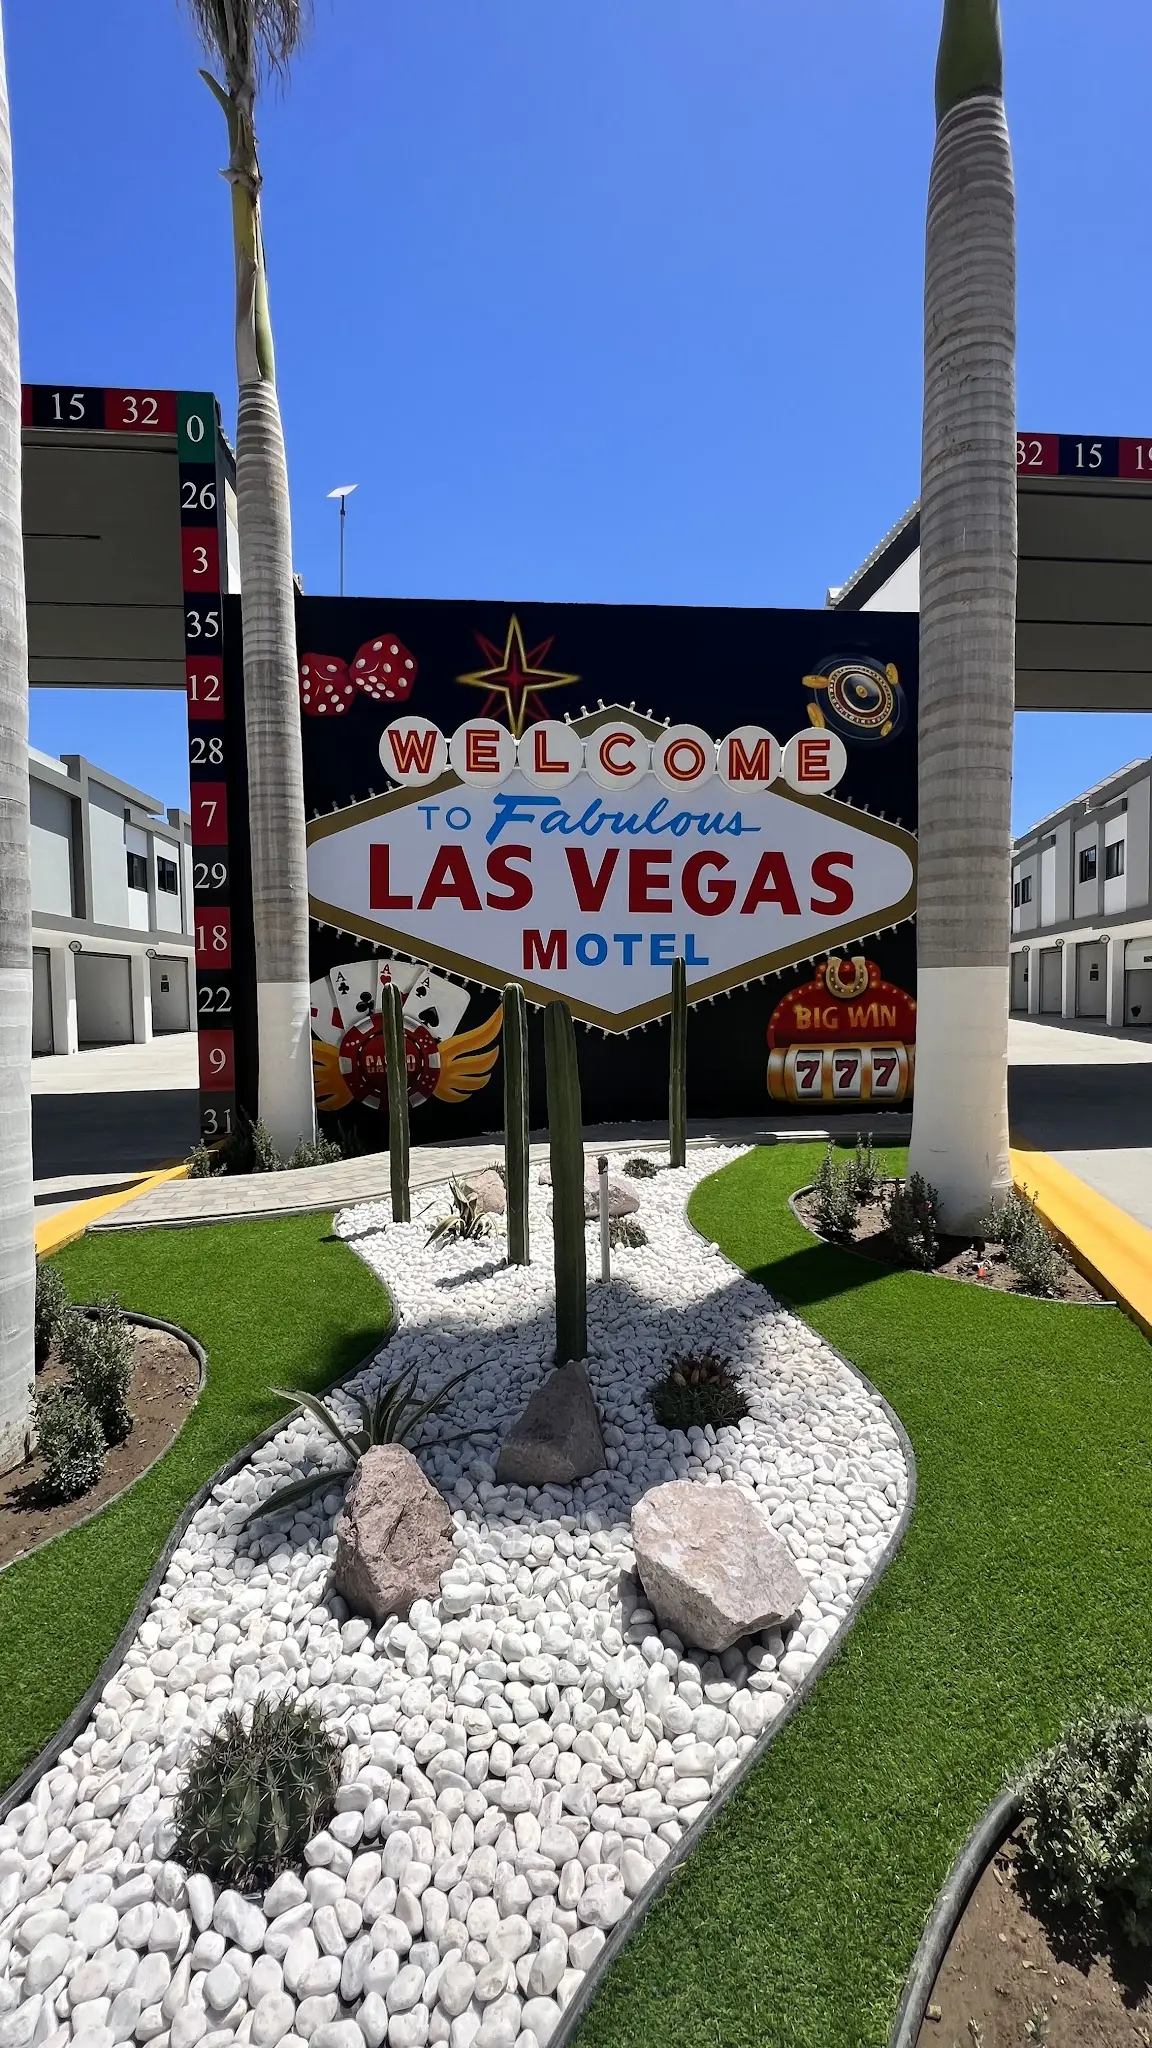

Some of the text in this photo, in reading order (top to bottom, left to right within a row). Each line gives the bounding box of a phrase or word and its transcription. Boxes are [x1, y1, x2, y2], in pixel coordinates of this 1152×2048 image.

[51, 393, 159, 425] 15 32
[186, 415, 205, 442] 0
[1075, 442, 1103, 468] 15
[1135, 445, 1152, 471] 1
[181, 481, 216, 510] 26
[192, 546, 209, 574] 3
[186, 611, 219, 638] 35
[189, 675, 221, 702] 12
[190, 737, 224, 764] 28
[387, 729, 831, 782] WELCOME
[200, 801, 218, 827] 7
[417, 792, 762, 846] TO Fabulous
[194, 862, 227, 889] 29
[368, 843, 854, 917] LAS VEGAS
[196, 925, 228, 951] 18
[522, 929, 710, 970] MOTEL
[336, 971, 347, 983] A
[380, 963, 392, 975] A
[421, 976, 431, 989] A
[198, 986, 232, 1013] 22
[796, 1004, 897, 1030] BIG WIN
[209, 1048, 227, 1075] 9
[203, 1108, 233, 1135] 31
